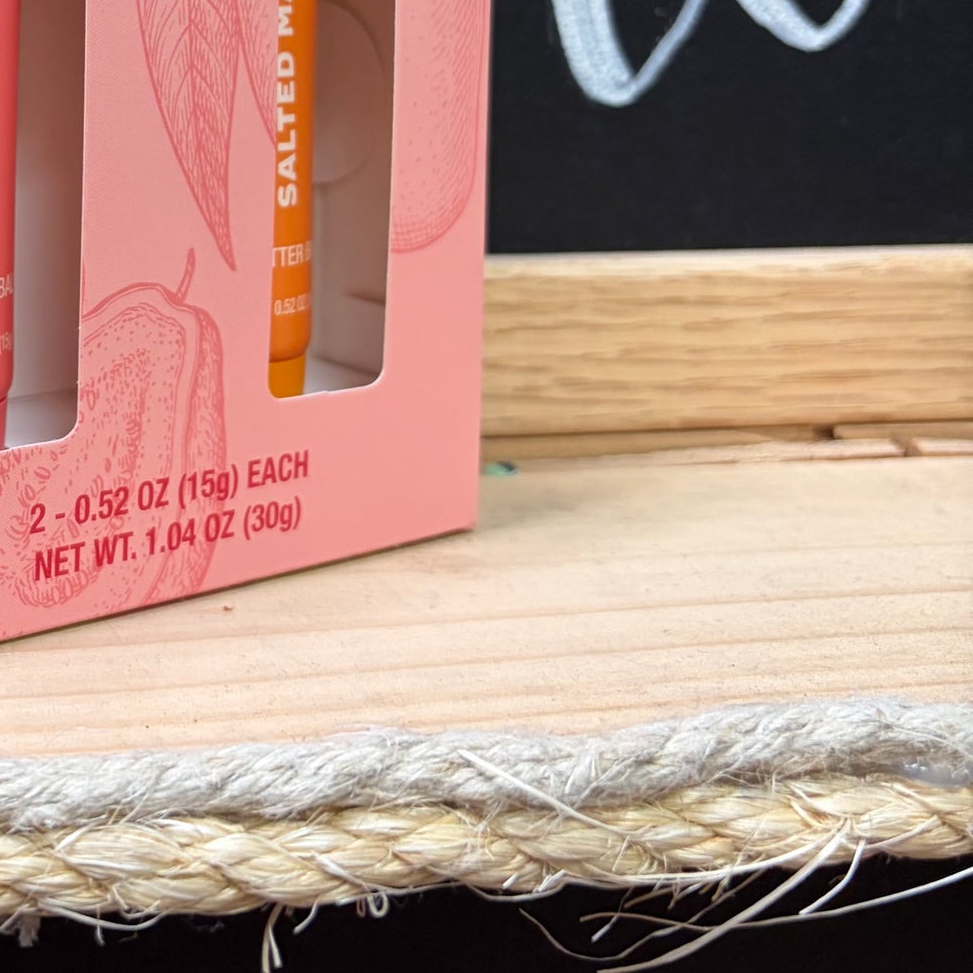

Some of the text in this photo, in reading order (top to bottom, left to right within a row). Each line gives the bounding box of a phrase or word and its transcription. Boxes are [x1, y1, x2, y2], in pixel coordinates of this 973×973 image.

[276, 51, 298, 209] SALTED
[28, 503, 47, 535] 2
[74, 486, 130, 526] 0.52
[136, 477, 170, 512] OZ
[177, 463, 240, 510] (15g)
[246, 449, 310, 489] EACH
[33, 494, 303, 582] NET WT. 1.04 OZ (30g)
